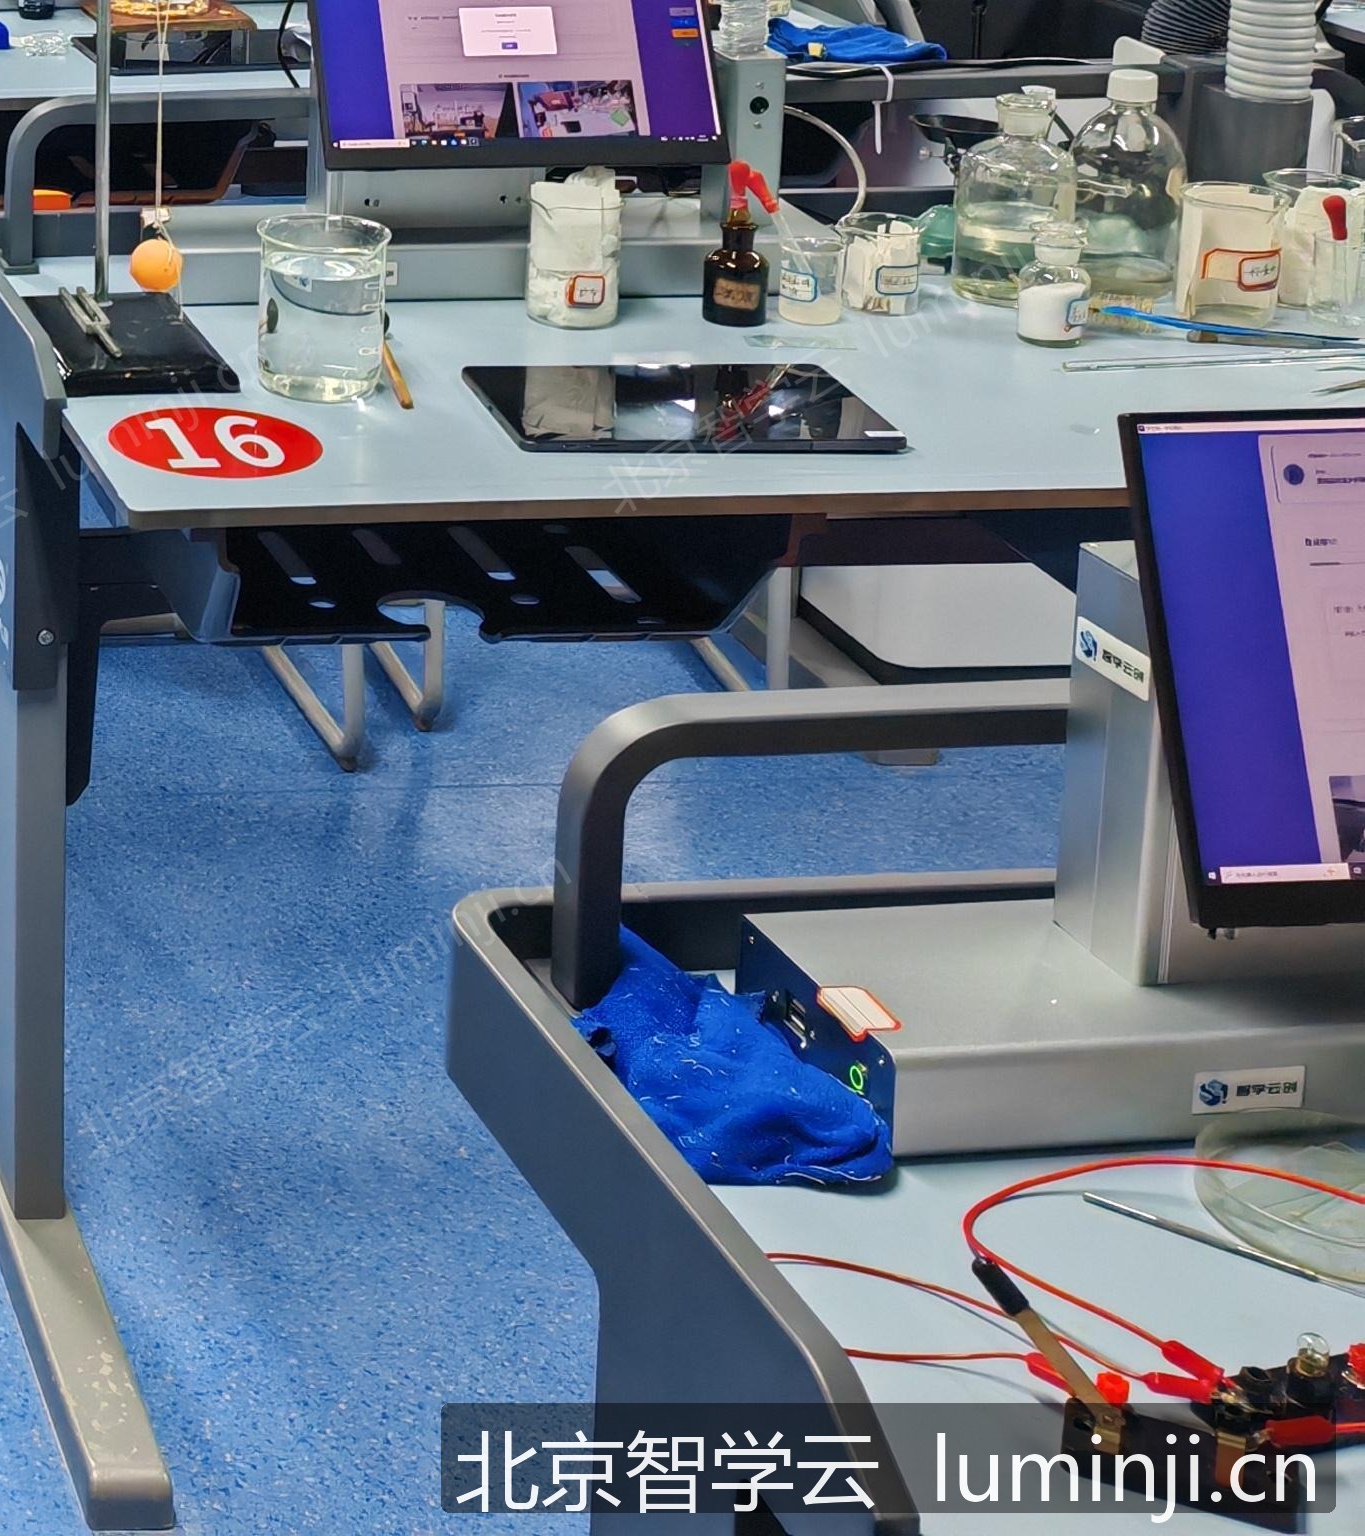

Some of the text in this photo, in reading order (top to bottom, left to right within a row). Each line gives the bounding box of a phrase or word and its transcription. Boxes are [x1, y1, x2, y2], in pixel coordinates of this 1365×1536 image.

[145, 415, 286, 469] 16
[1235, 1081, 1298, 1097] 智学云创
